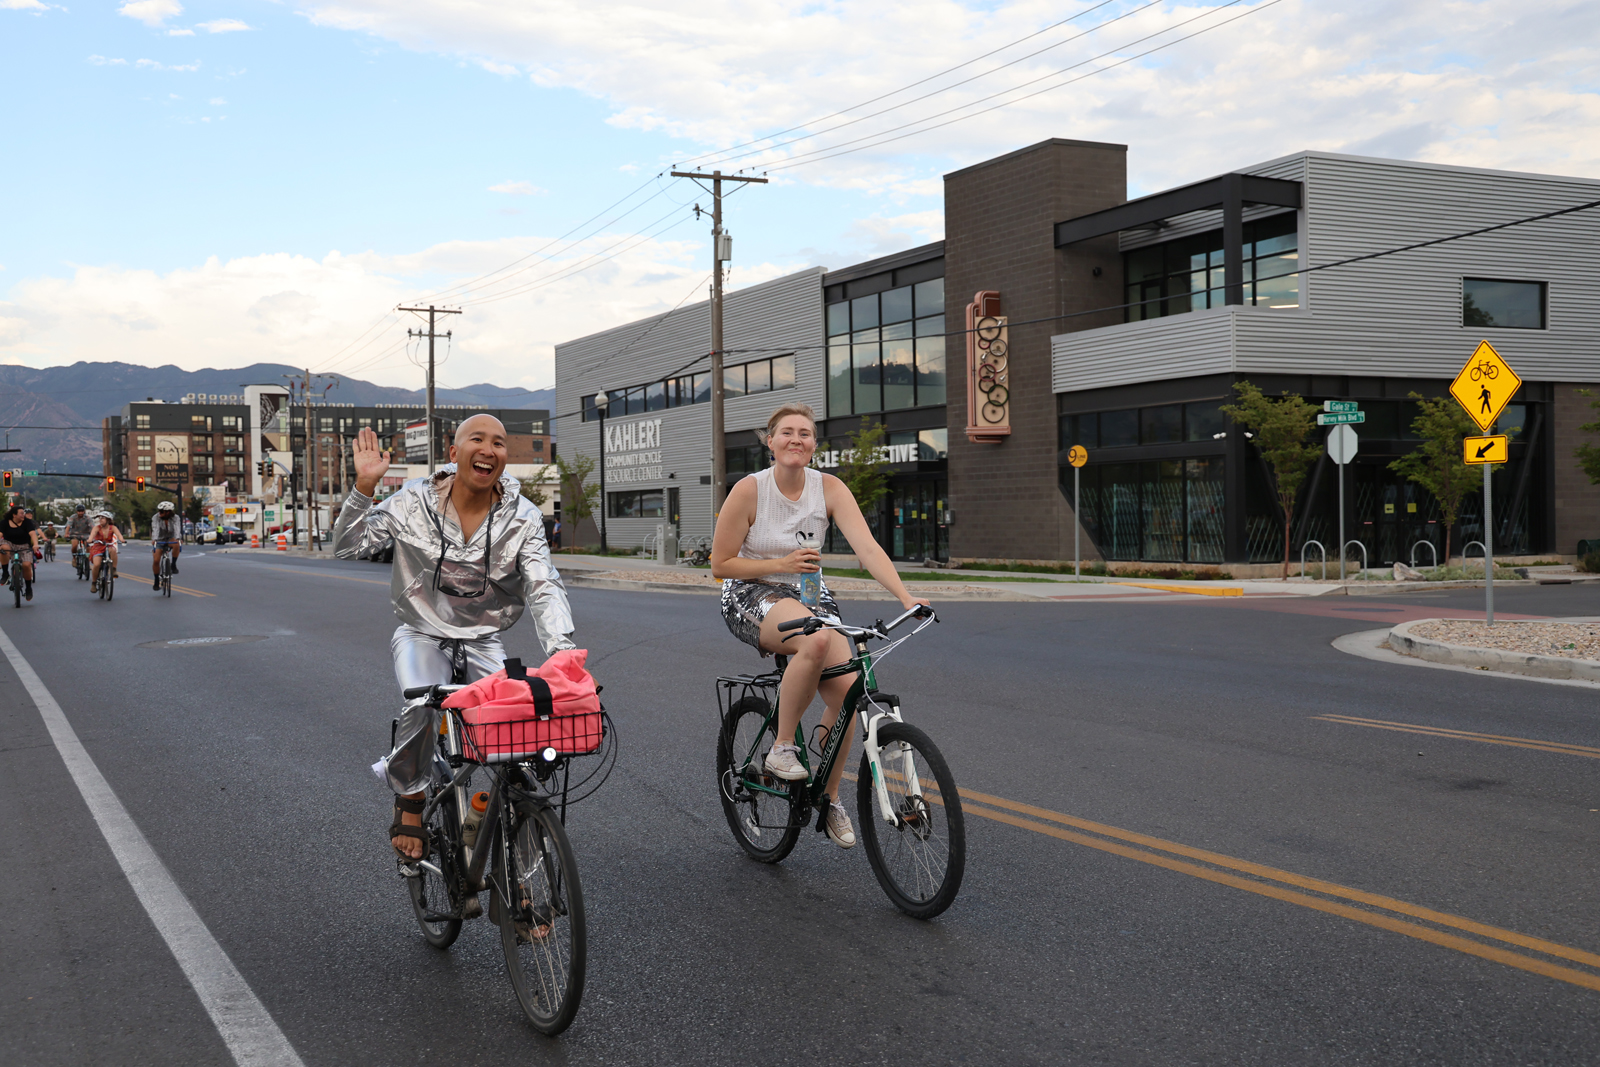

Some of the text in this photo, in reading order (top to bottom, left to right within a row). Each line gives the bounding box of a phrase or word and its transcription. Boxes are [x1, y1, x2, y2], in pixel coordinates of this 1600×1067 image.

[1332, 403, 1343, 411] Gale
[1344, 403, 1350, 411] St
[1347, 413, 1357, 421] Blvd
[417, 429, 428, 437] TIRES
[606, 419, 662, 453] KAHLERT
[606, 450, 662, 468] COMMUNITY BICYCLE
[1068, 448, 1077, 463] 9
[606, 465, 662, 483] RESOURCE CENTER
[819, 704, 847, 770] RALEIGH
